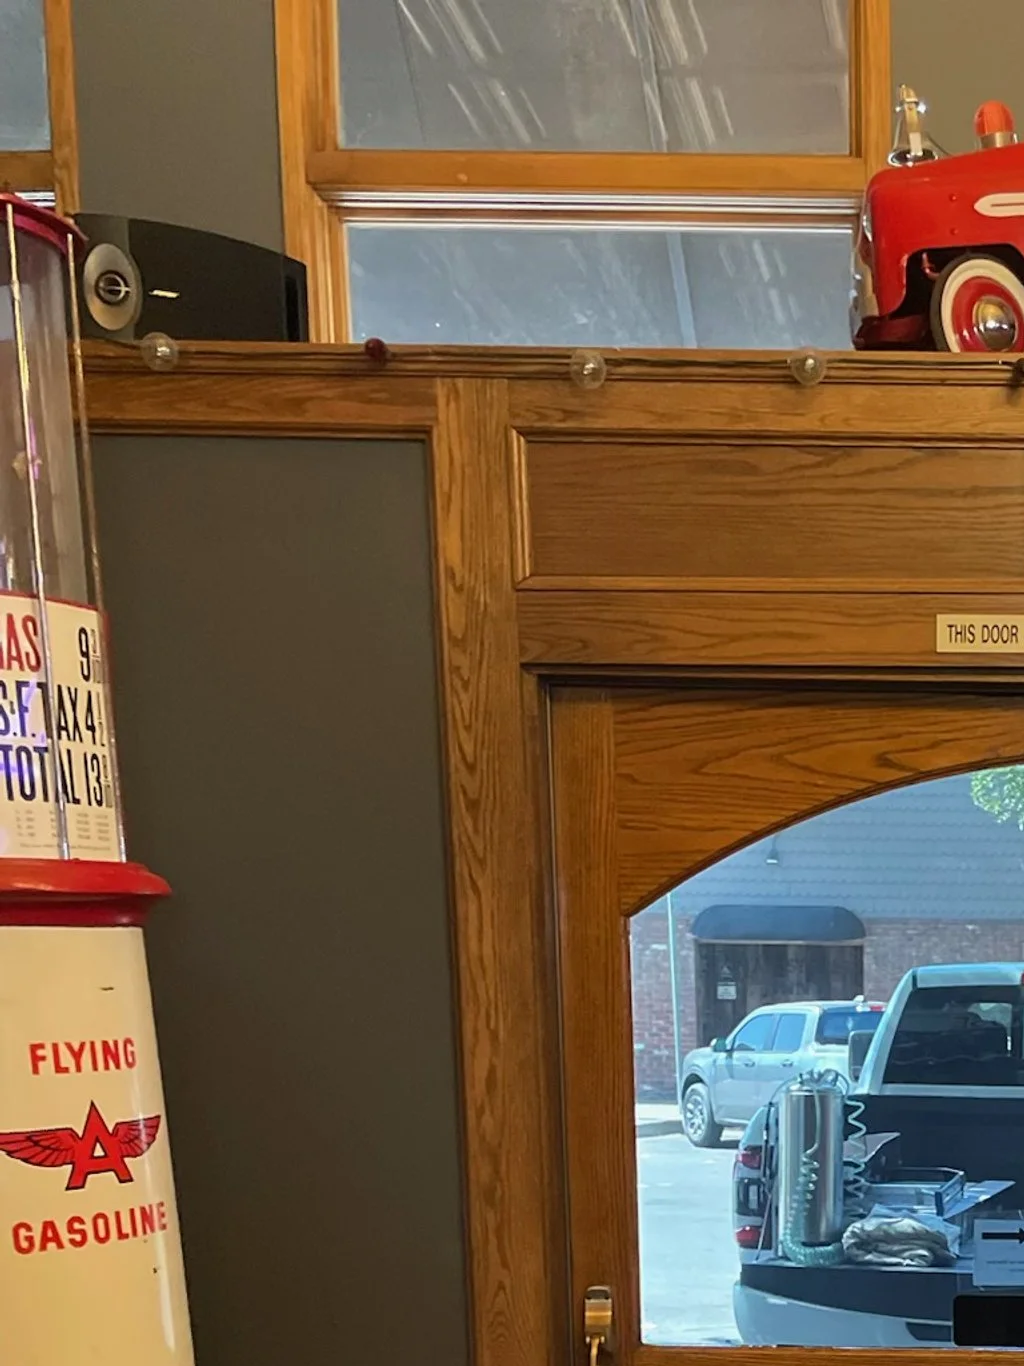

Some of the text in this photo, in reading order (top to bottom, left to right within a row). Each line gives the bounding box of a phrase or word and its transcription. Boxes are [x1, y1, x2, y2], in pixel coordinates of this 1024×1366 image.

[0, 613, 41, 672] AS
[78, 627, 90, 683] 9
[946, 623, 975, 644] THIS
[981, 624, 1019, 644] DOOR
[0, 744, 82, 806] TOTAL
[83, 752, 104, 808] 13
[29, 1037, 137, 1075] FLYING
[65, 1099, 135, 1191] A
[12, 1201, 168, 1255] GASOLINE
